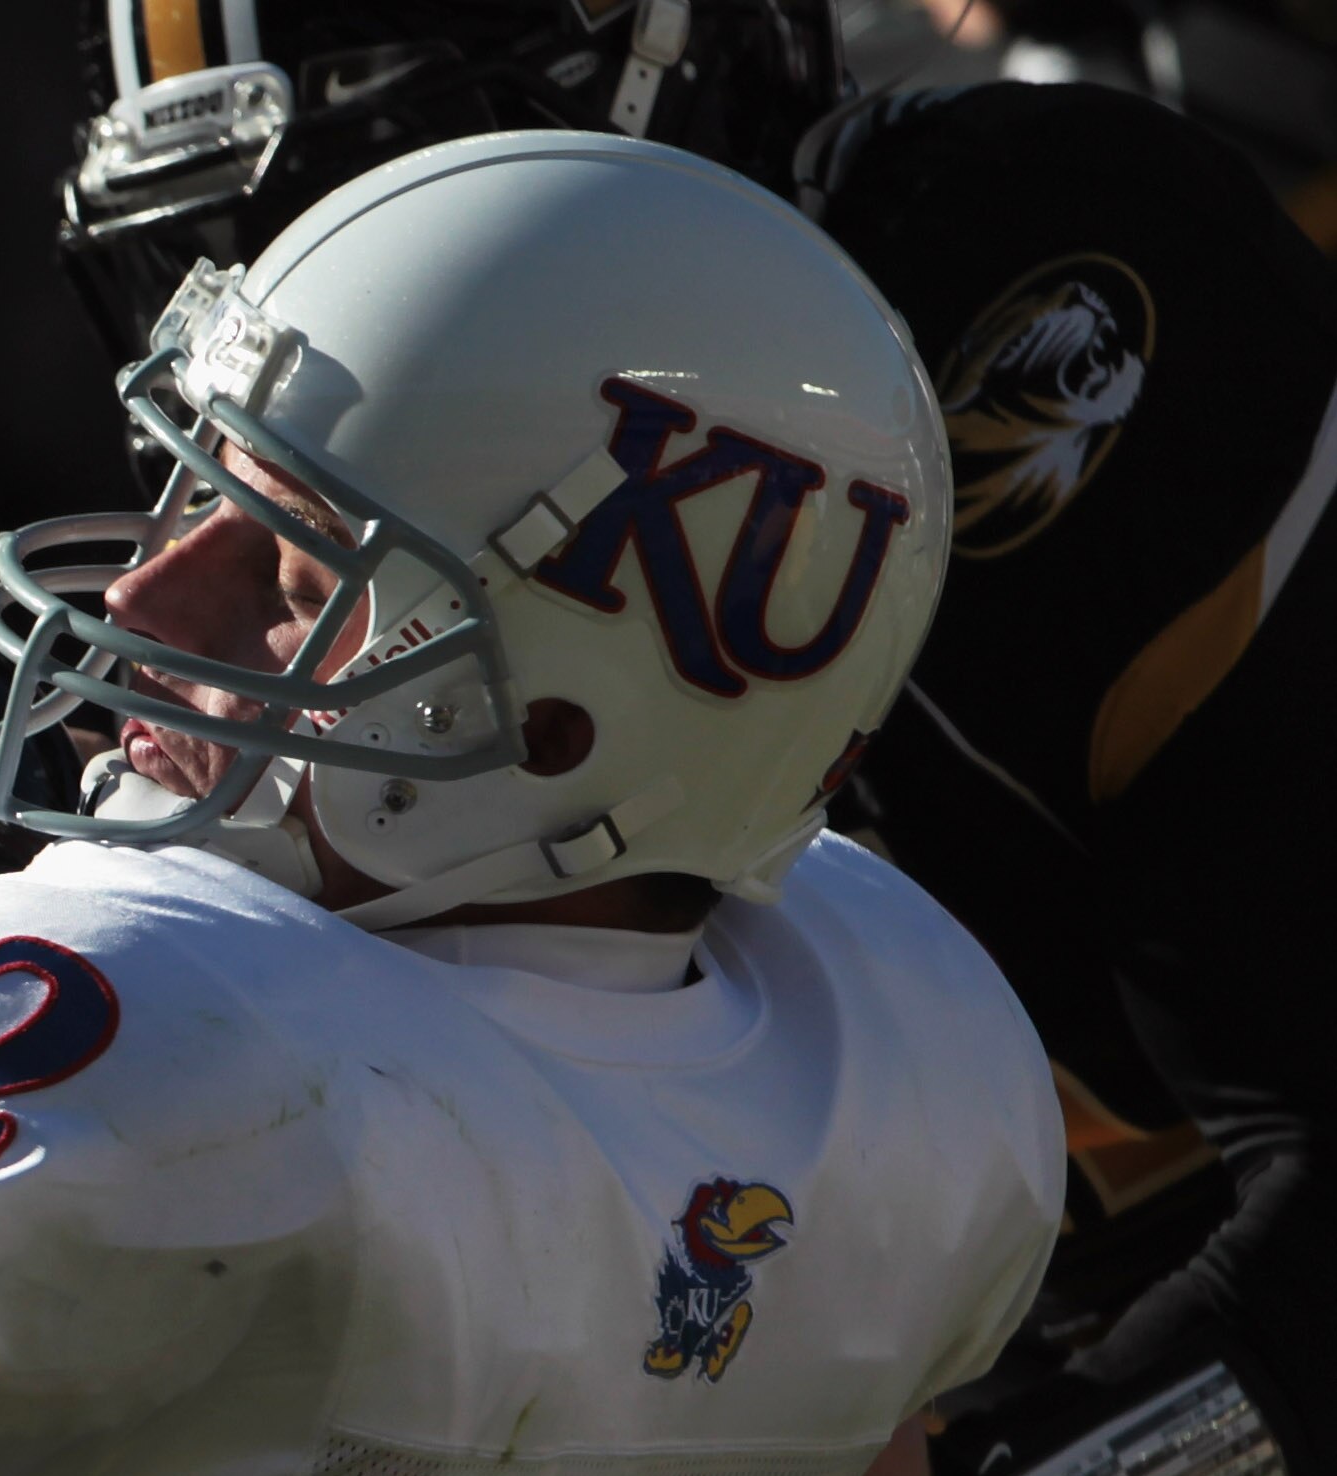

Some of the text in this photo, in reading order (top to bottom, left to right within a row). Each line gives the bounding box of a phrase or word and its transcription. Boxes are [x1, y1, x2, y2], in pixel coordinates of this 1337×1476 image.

[144, 90, 224, 128] MIZZOU
[531, 376, 909, 698] KU
[686, 1288, 721, 1328] KU
